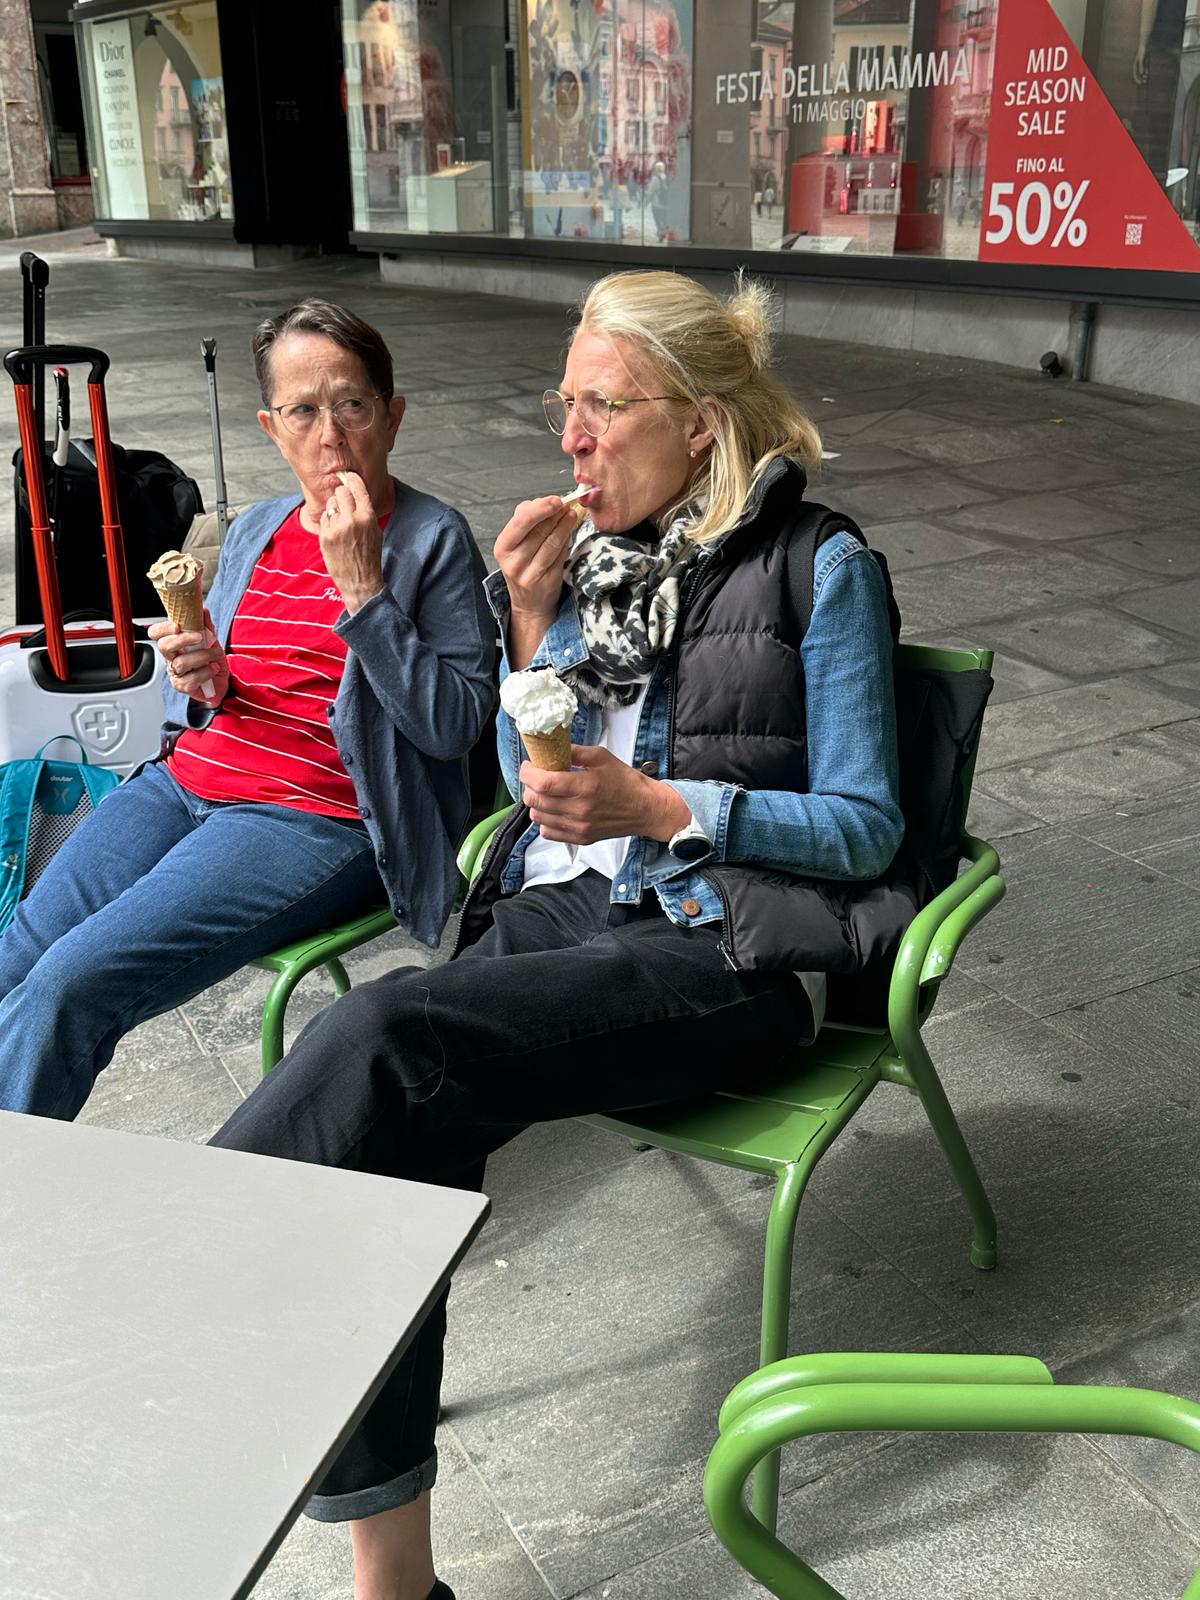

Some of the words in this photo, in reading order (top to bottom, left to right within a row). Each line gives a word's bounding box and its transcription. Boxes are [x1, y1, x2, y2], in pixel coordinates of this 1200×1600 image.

[99, 41, 125, 62] Dior
[1026, 47, 1068, 74] MID
[104, 69, 126, 79] CHANEL
[716, 71, 774, 105] FESTA
[781, 62, 850, 98] DELLA
[858, 49, 970, 93] MAMMA
[1004, 76, 1086, 106] SEASON
[792, 103, 803, 124] 11
[806, 98, 867, 123] MAGGIO
[1017, 110, 1067, 136] SALE
[1016, 157, 1046, 173] FINO
[1048, 157, 1065, 173] AL
[985, 180, 1091, 247] 50%
